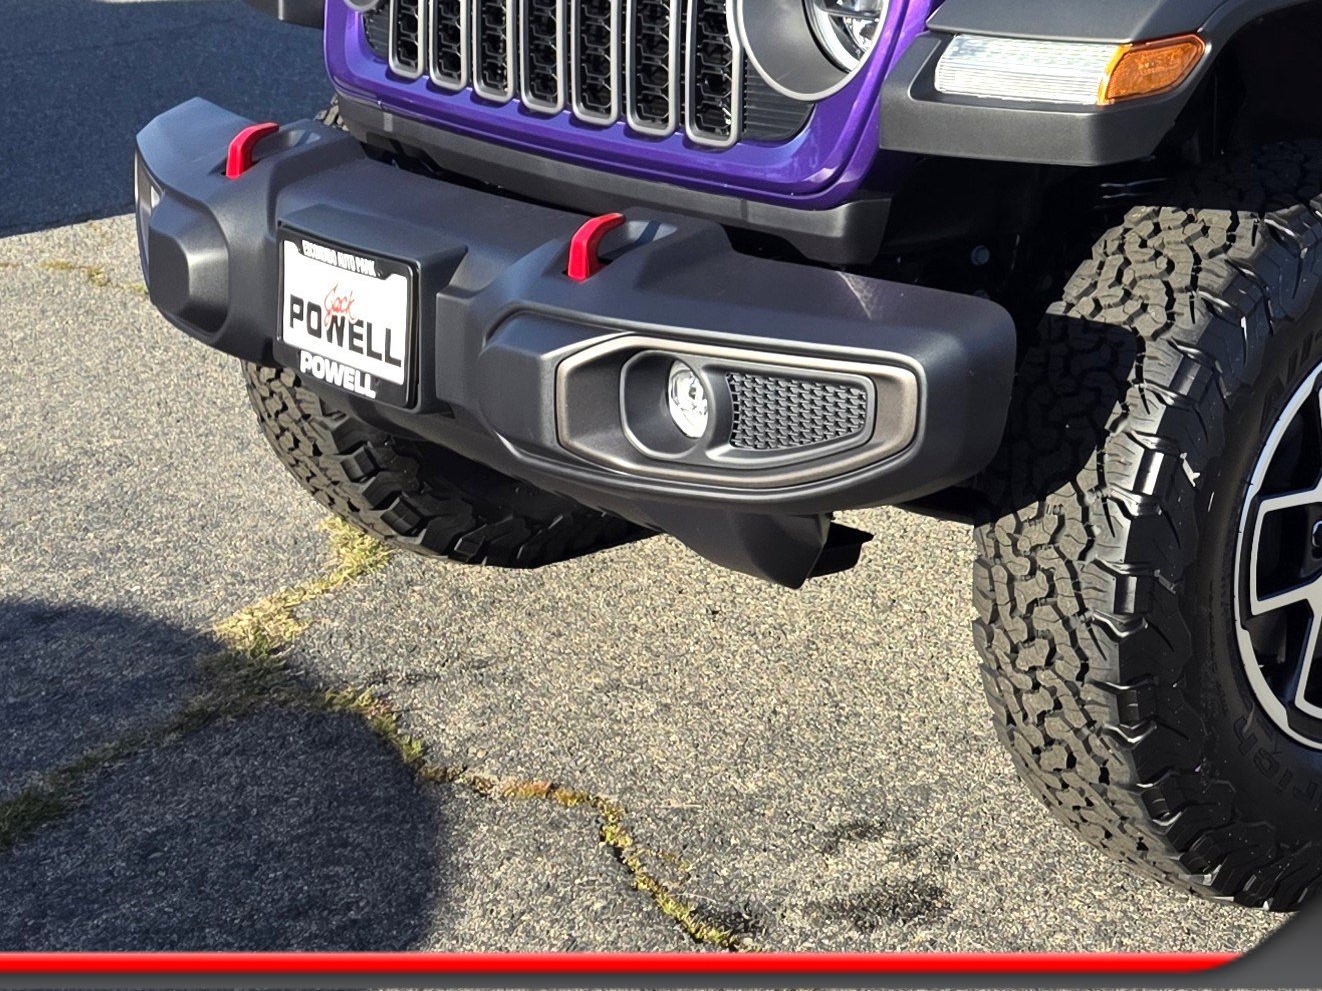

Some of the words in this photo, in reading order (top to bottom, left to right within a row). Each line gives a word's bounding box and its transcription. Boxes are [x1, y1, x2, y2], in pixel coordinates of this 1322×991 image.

[323, 282, 358, 328] Jack
[289, 294, 402, 368] POWELL
[299, 350, 377, 399] POWELL
